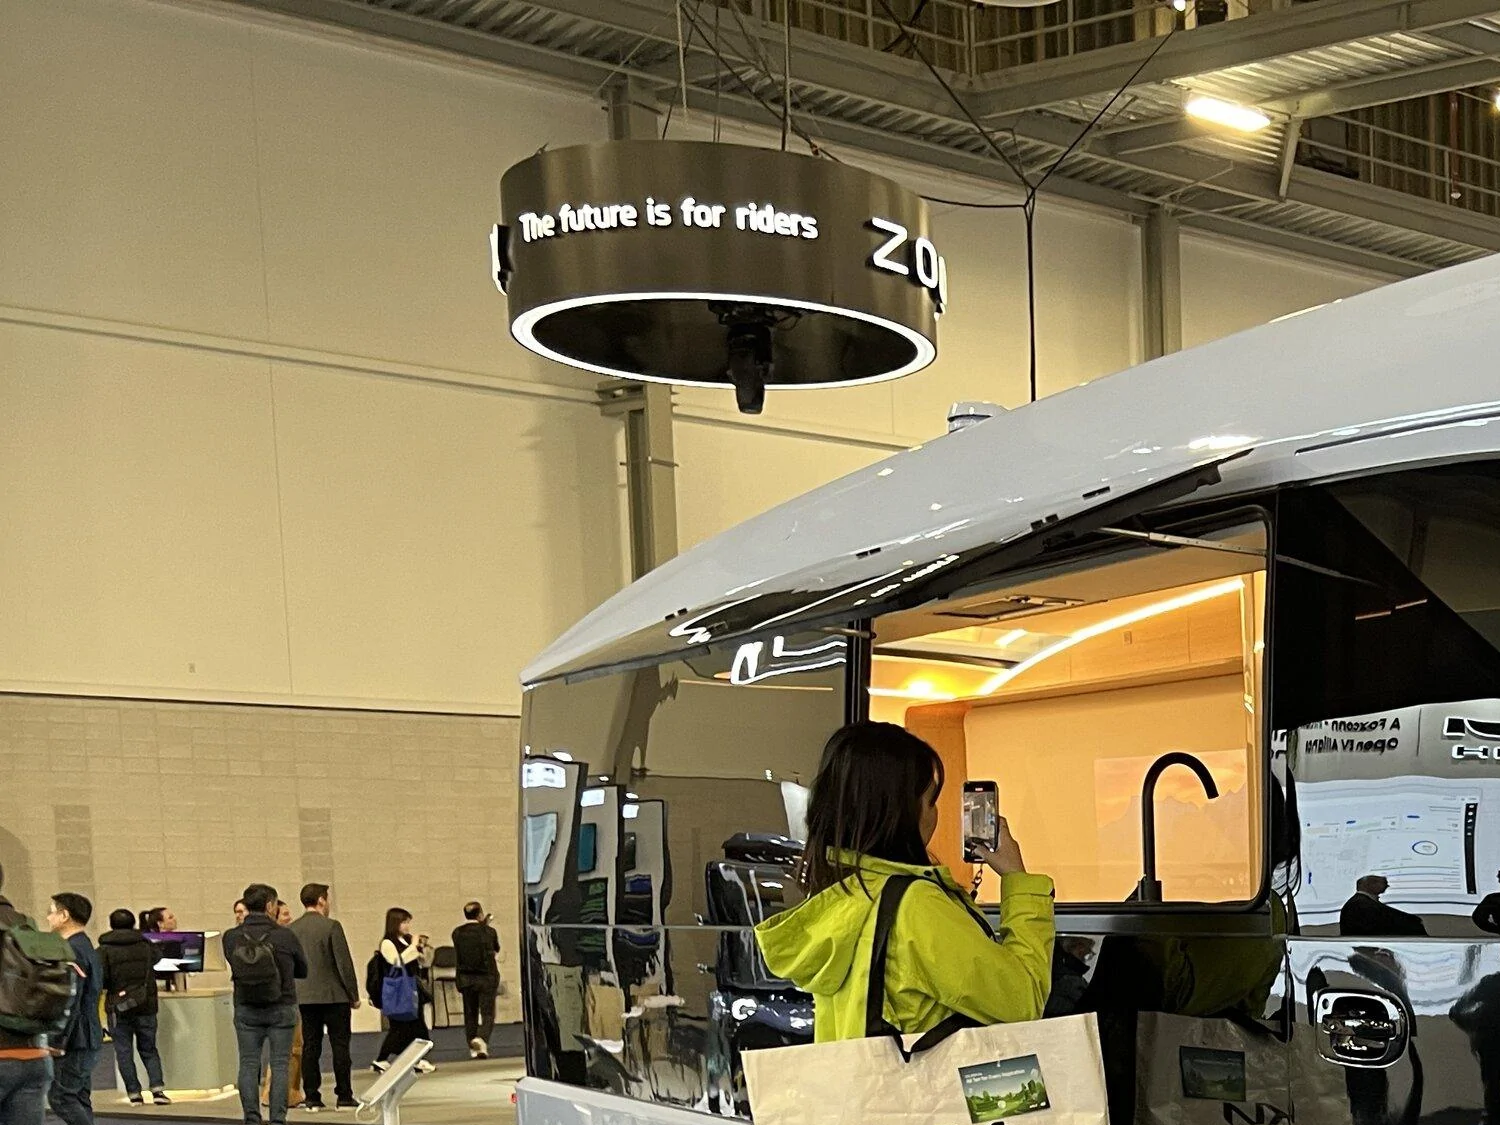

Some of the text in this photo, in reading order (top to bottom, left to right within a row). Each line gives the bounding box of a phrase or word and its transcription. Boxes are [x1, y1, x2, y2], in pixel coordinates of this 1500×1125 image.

[518, 197, 819, 243] The future is for riders
